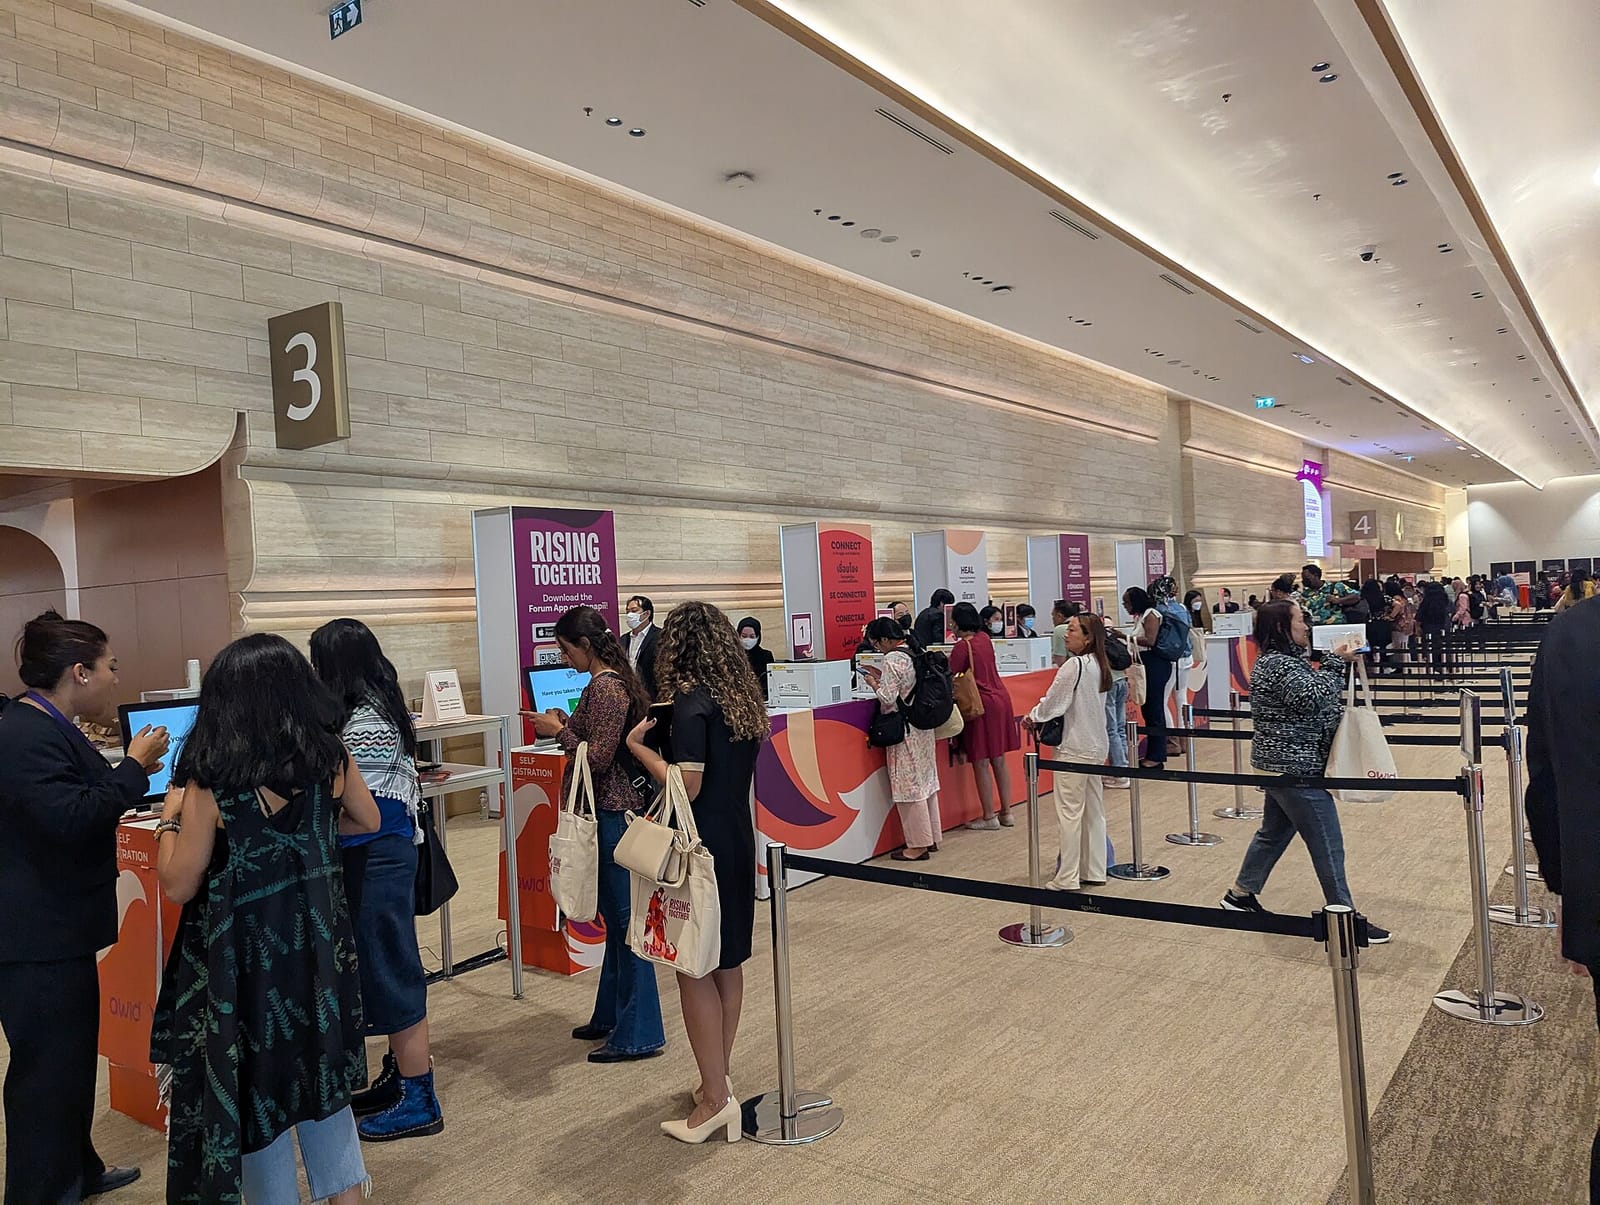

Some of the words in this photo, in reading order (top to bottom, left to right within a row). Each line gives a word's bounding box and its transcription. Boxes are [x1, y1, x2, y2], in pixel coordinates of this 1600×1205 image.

[284, 331, 321, 421] 3
[1353, 515, 1372, 535] 4
[530, 531, 600, 562] RISING
[831, 541, 862, 550] CONNECT
[532, 564, 602, 586] TOGETHER
[960, 566, 975, 574] HEAL
[542, 593, 579, 602] Download
[580, 593, 593, 601] the
[829, 591, 836, 599] SE
[836, 590, 867, 599] CONNECTER
[528, 604, 553, 613] Forum
[553, 603, 569, 614] App
[835, 614, 865, 623] CONECTAR
[799, 626, 805, 639] 1
[562, 687, 576, 695] taken
[519, 756, 536, 765] SELF
[512, 767, 553, 777] GISTRATION
[118, 832, 131, 844] ELF
[669, 898, 691, 913] RISING
[668, 909, 690, 921] TOGETHER
[109, 996, 141, 1022] awid
